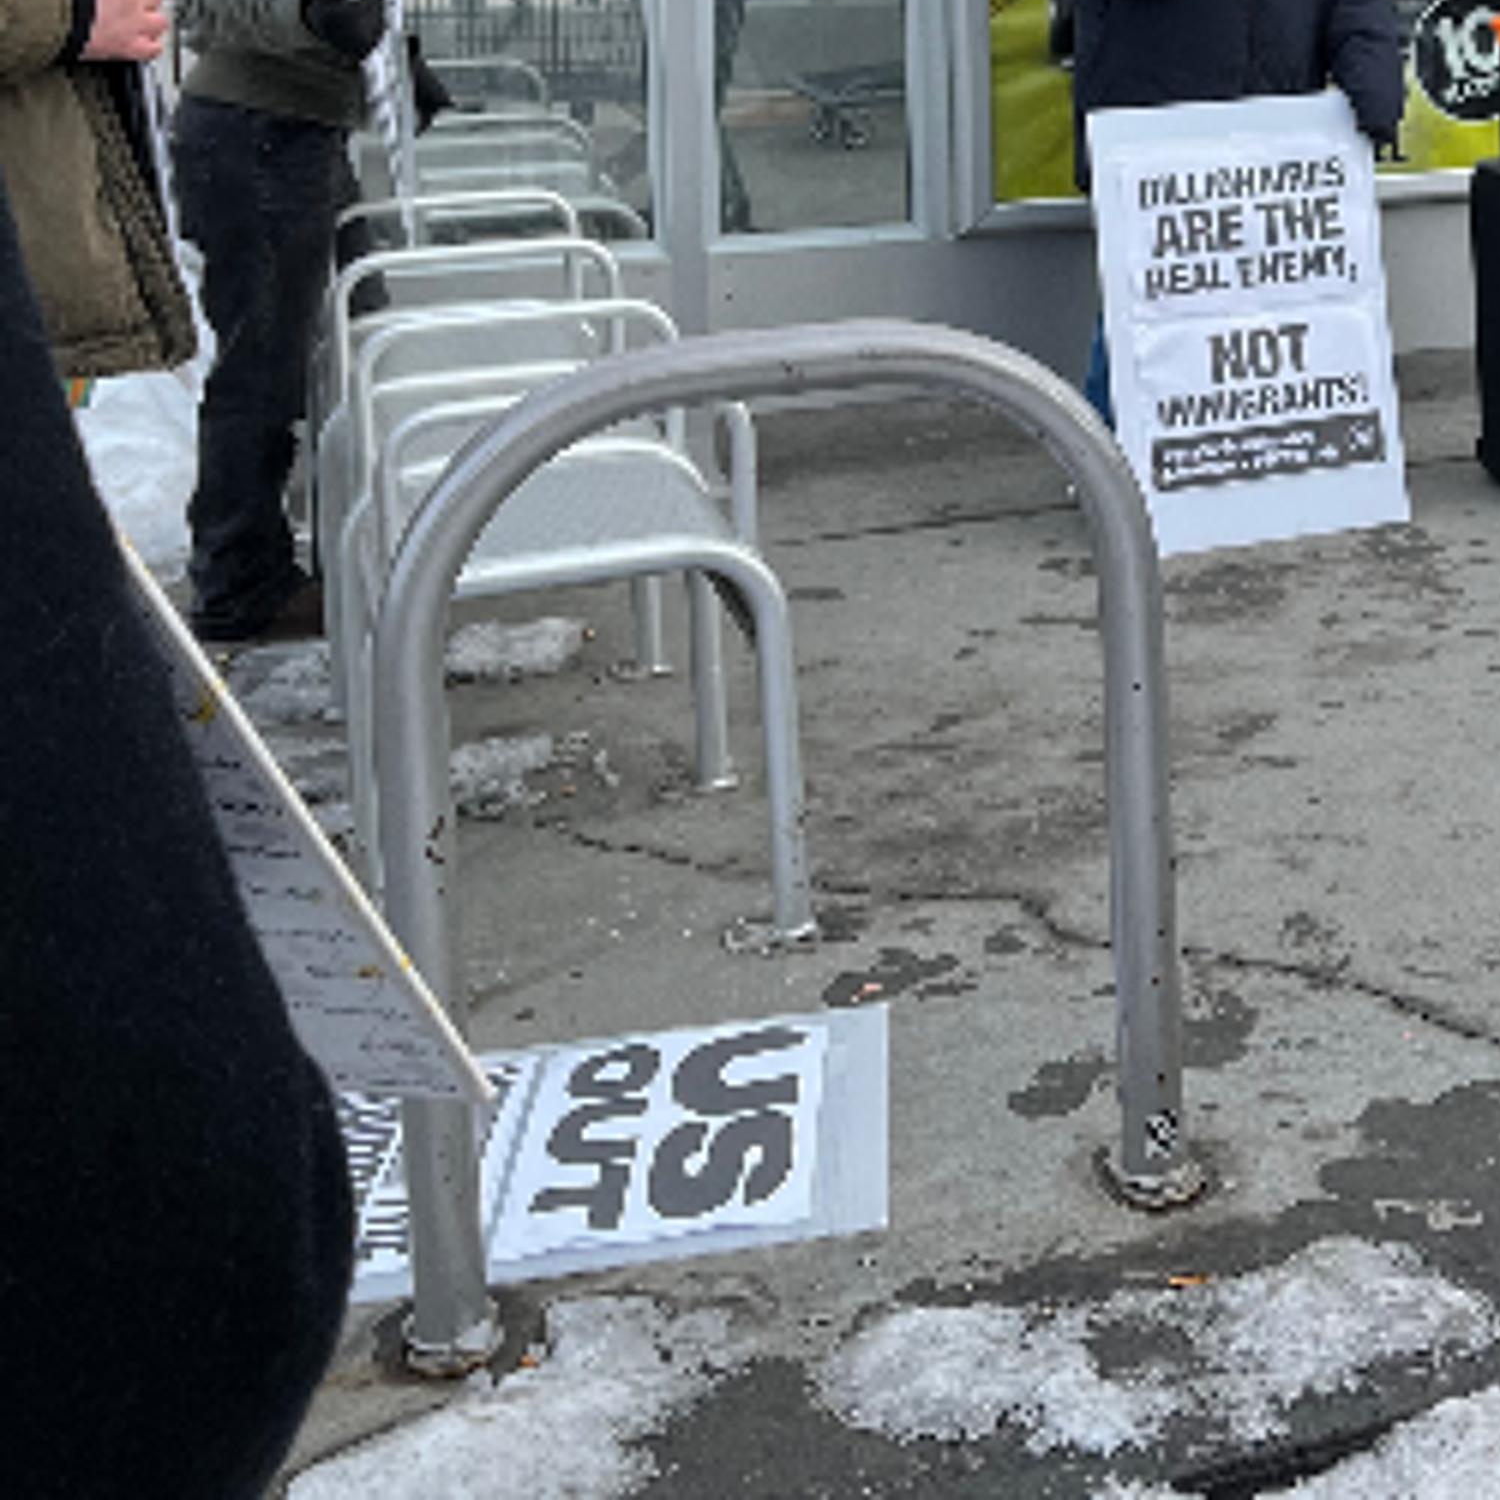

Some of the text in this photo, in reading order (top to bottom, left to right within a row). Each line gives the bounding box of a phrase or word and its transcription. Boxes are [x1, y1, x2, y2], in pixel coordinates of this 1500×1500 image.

[1152, 194, 1345, 259] ARE THE
[1145, 263, 1231, 300] REAL
[1207, 323, 1309, 384] NOT
[527, 1042, 662, 1230] OUT
[647, 1025, 812, 1219] US
